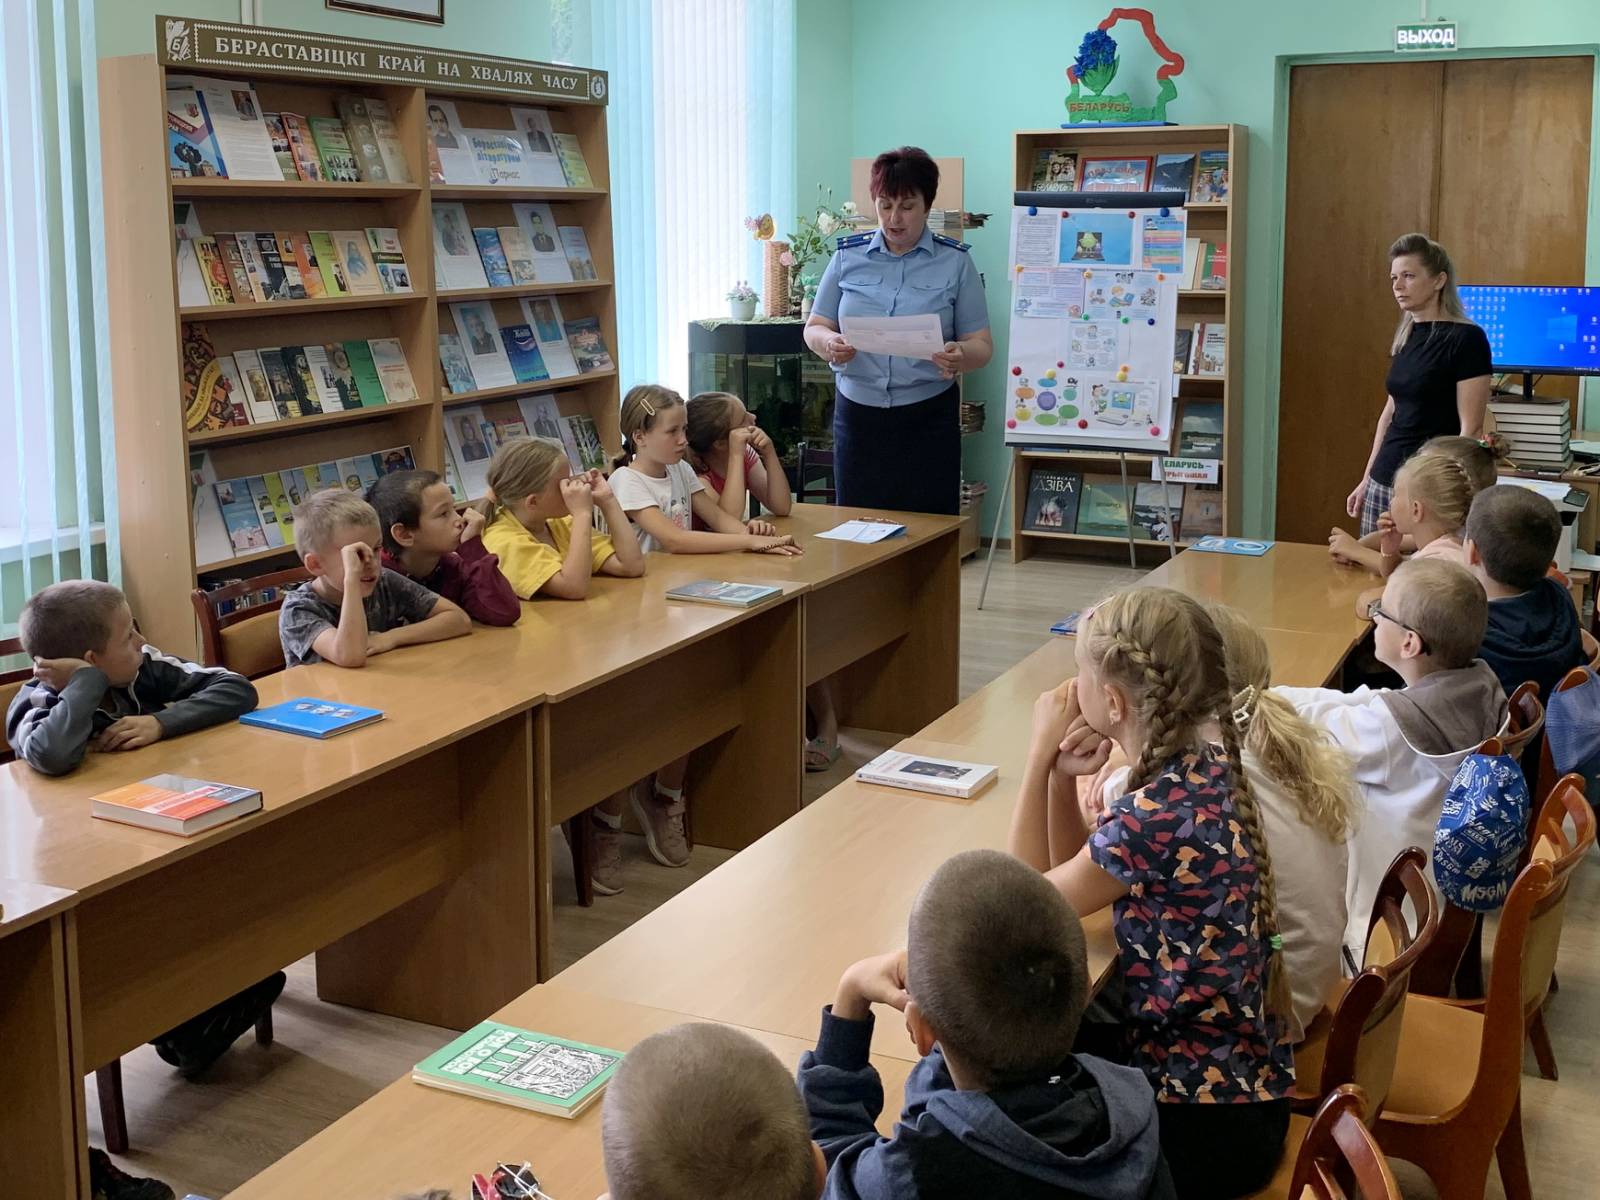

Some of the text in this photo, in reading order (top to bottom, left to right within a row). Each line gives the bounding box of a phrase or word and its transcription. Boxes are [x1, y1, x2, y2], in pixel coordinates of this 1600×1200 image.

[1397, 28, 1454, 45] ВЫХОД
[215, 36, 578, 90] БЕРАСТАВІЦКІ КРАЙ НА ХВАЛЯХ ЧАСУ
[1069, 102, 1130, 112] БЕЛАРУСЬ
[1164, 460, 1204, 469] ЕЛАРУСЬ
[1033, 479, 1074, 492] ДЗІВА
[1461, 881, 1508, 904] MSGM
